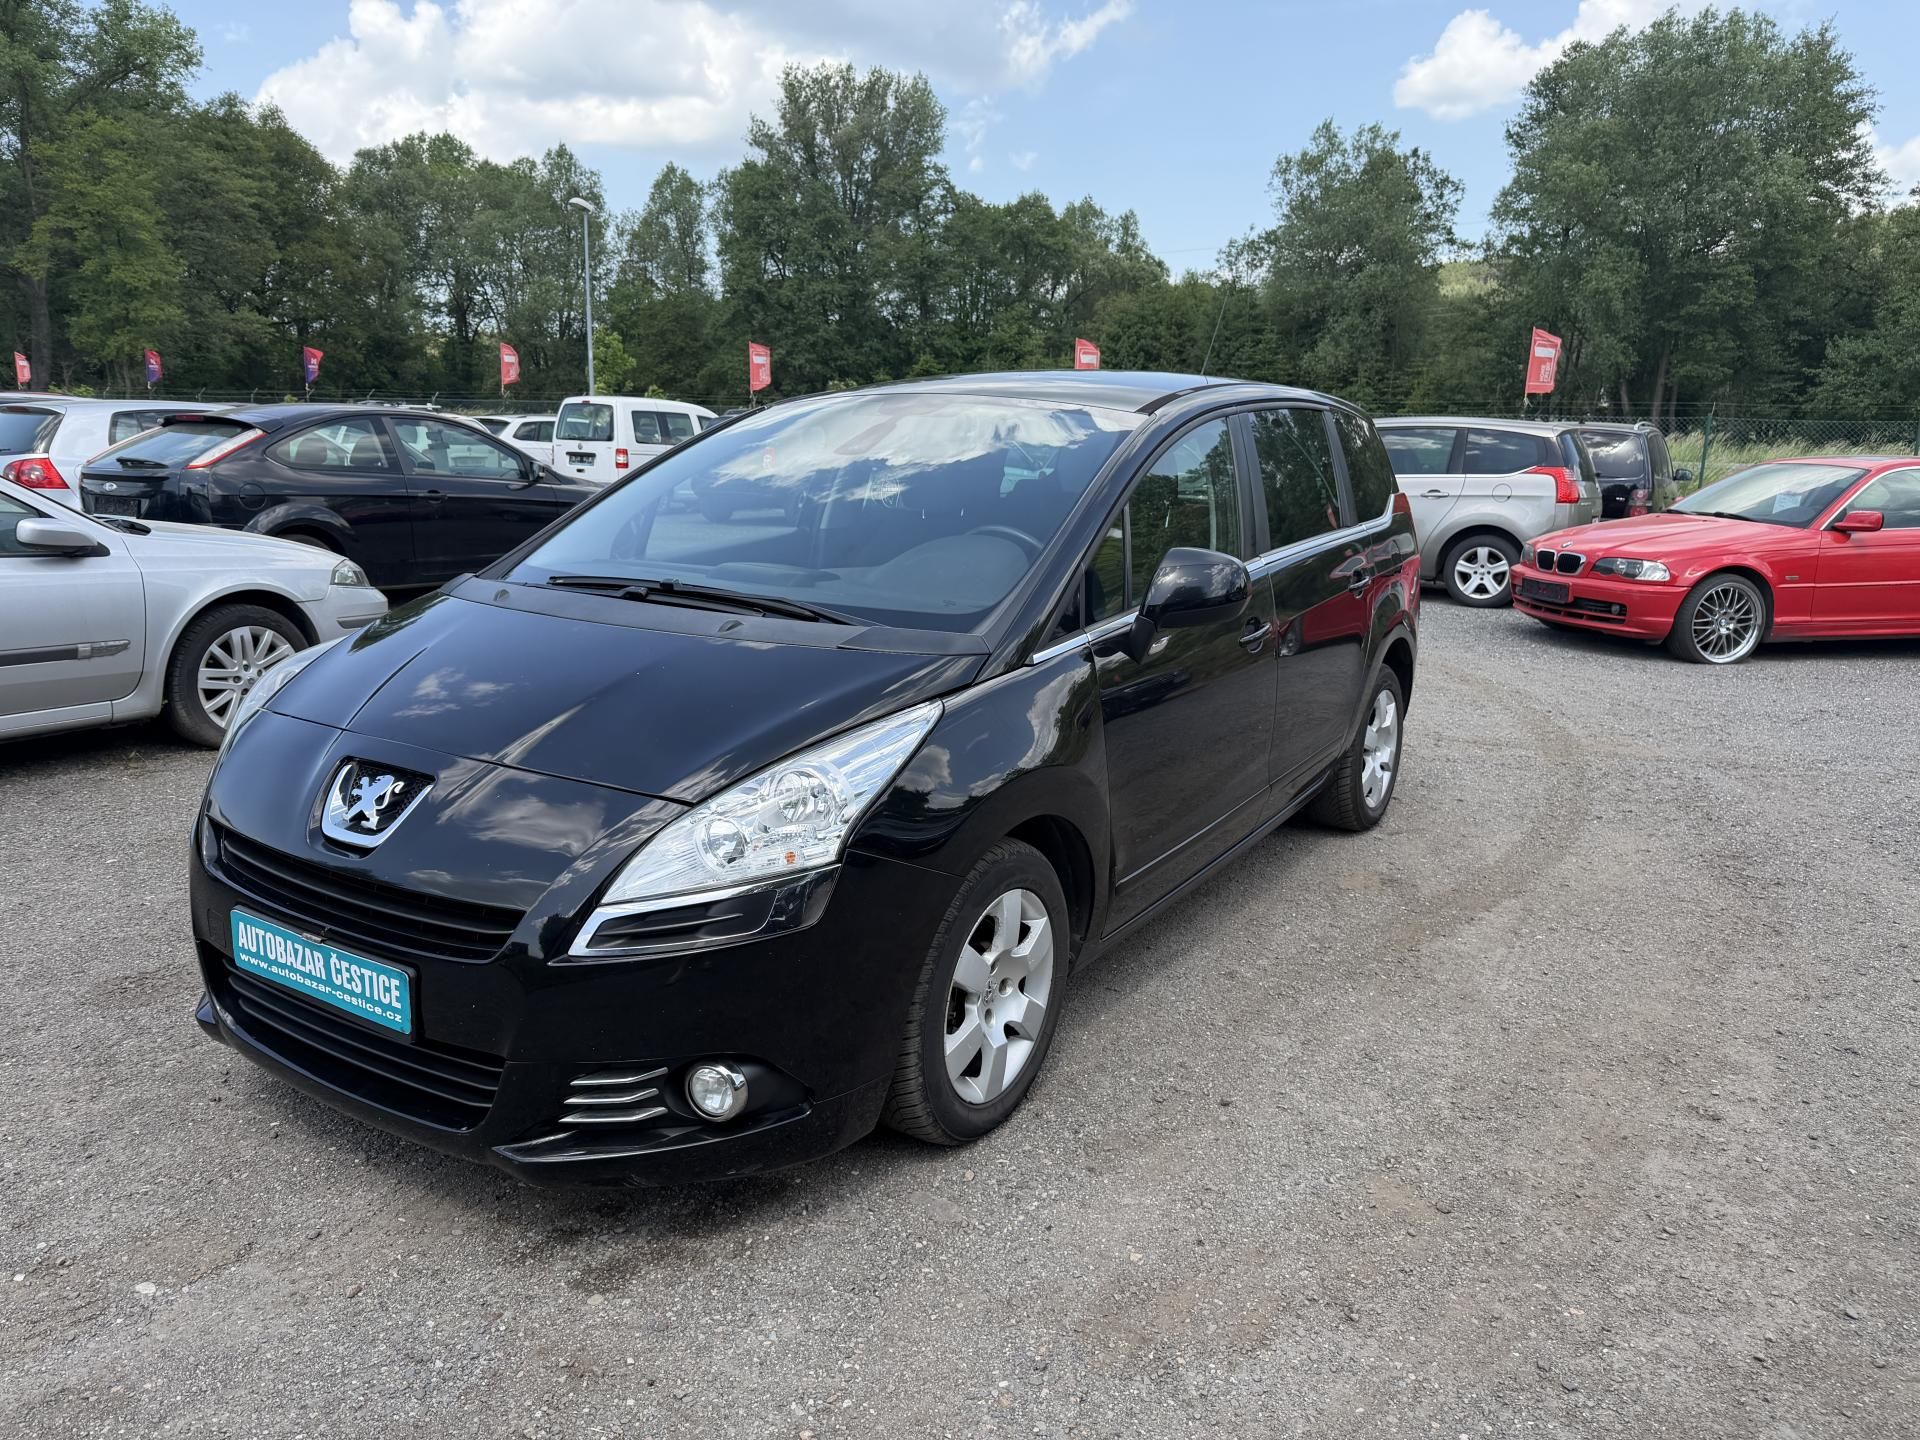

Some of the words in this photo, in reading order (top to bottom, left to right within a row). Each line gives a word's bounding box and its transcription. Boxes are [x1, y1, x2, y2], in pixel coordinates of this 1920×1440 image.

[238, 921, 327, 980] AUTOBAZAR
[330, 952, 402, 1009] ČESTICE
[239, 952, 403, 1023] www.autobazar-cestice.cz
